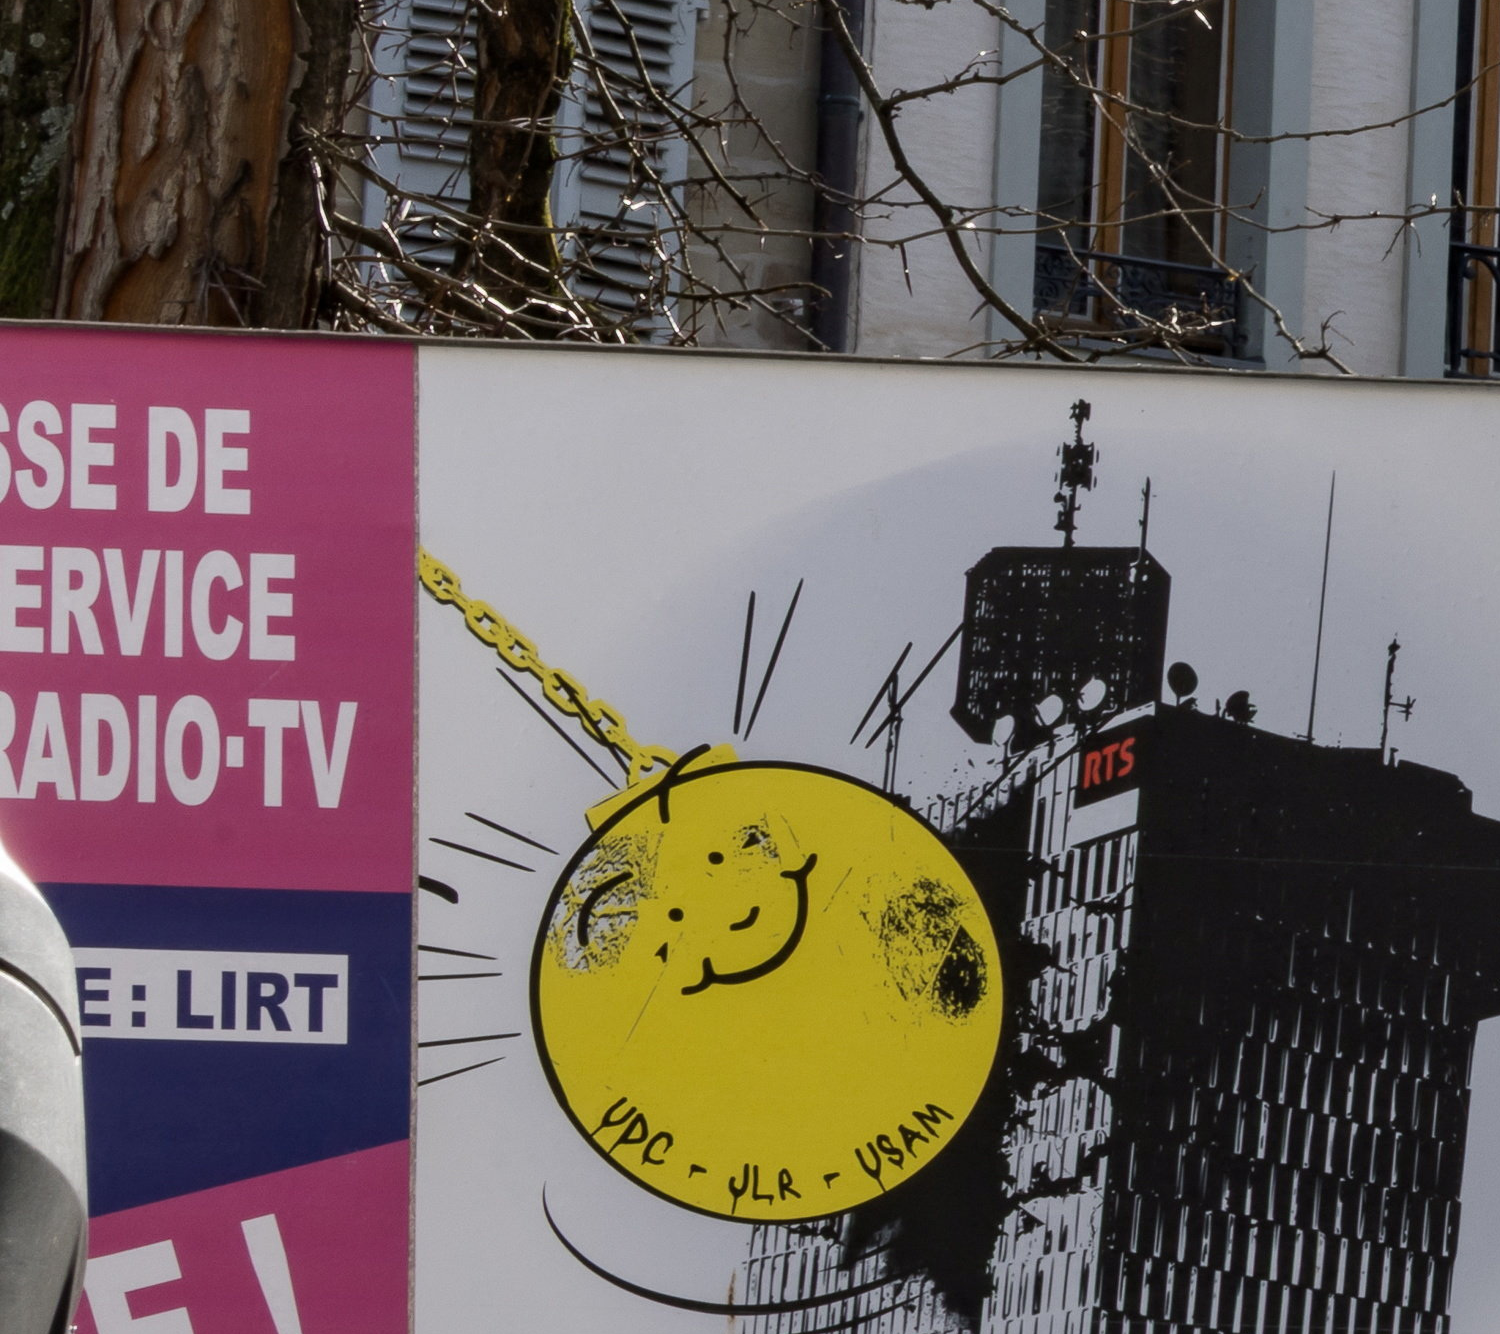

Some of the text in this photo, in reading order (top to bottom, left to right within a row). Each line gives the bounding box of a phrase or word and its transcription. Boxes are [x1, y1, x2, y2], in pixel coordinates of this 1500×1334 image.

[0, 400, 251, 515] SE DE
[0, 545, 296, 662] ERVICE
[1083, 737, 1136, 789] RTS
[176, 971, 338, 1033] LIRT
[589, 1097, 674, 1165] UDC
[855, 1103, 955, 1193] USAM
